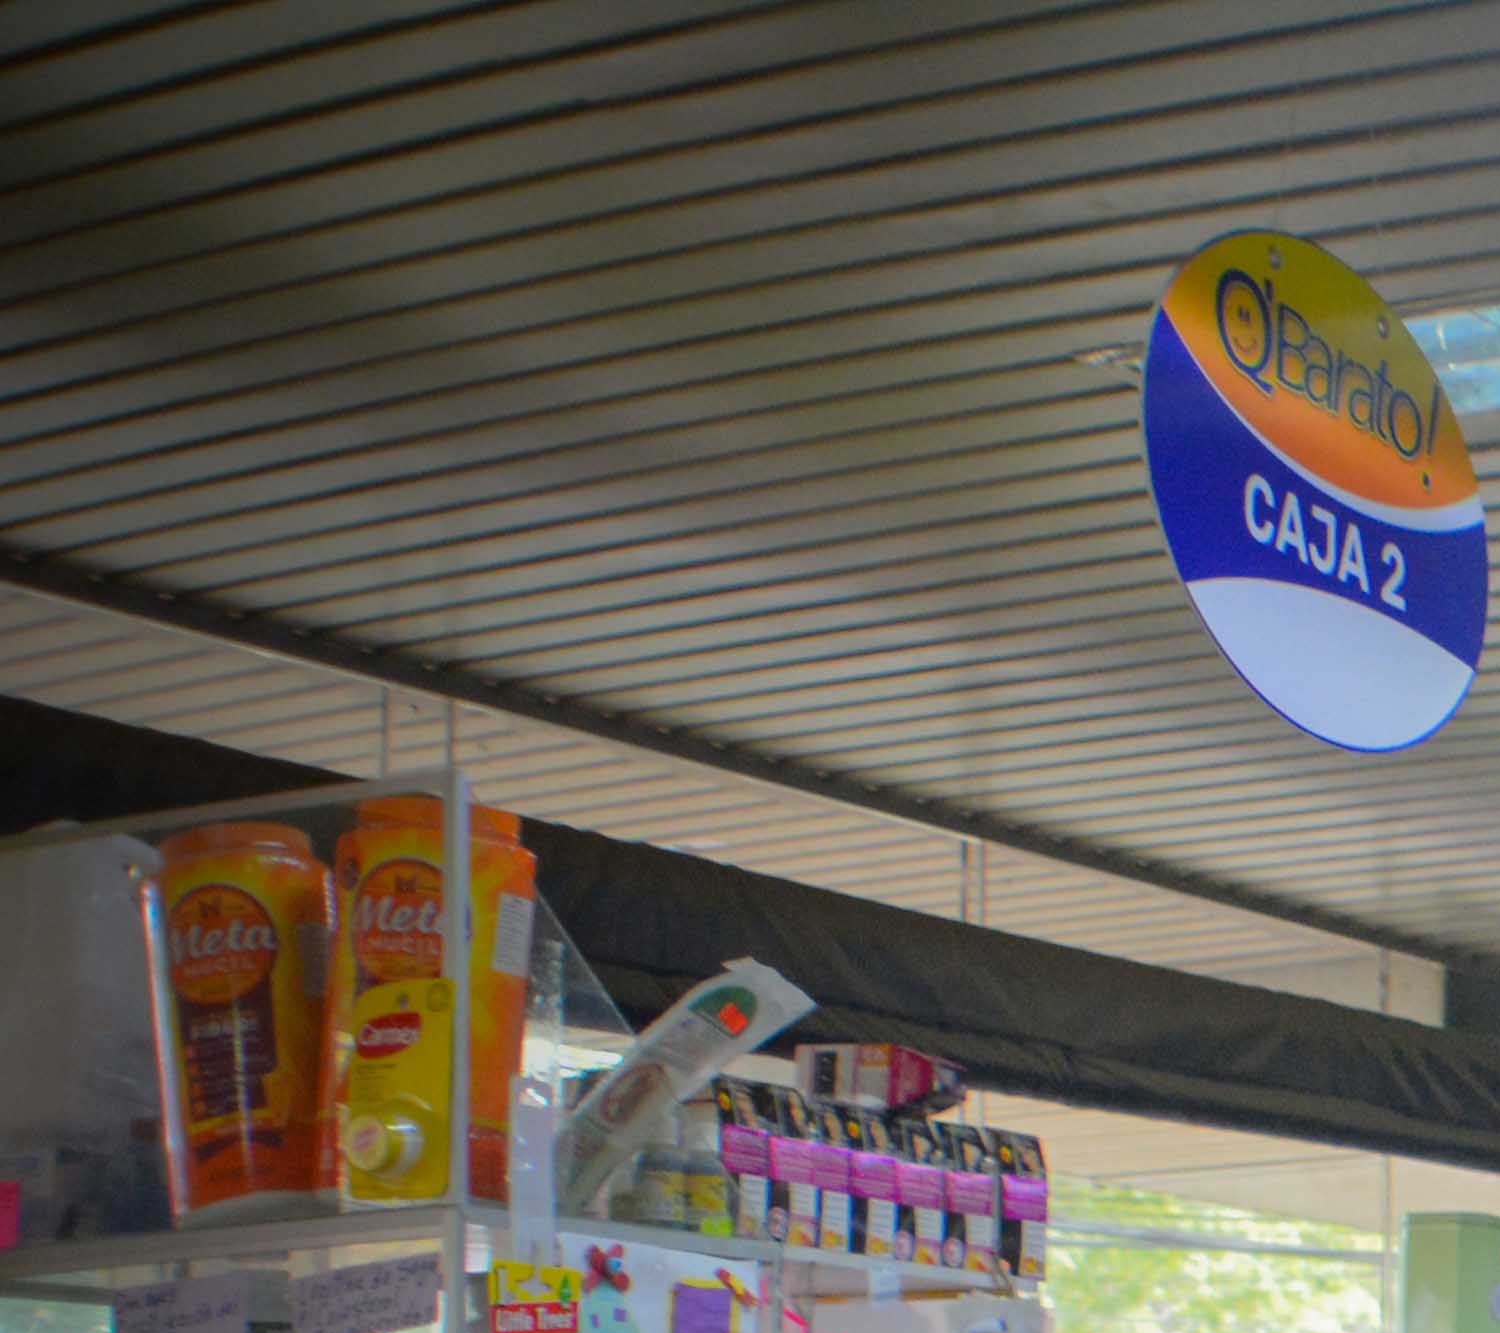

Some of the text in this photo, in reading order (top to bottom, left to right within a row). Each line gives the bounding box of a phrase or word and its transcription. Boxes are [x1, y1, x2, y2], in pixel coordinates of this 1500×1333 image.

[1244, 473, 1407, 611] CAJA 2
[351, 896, 446, 933] Met
[495, 1304, 576, 1333] Little Trees
